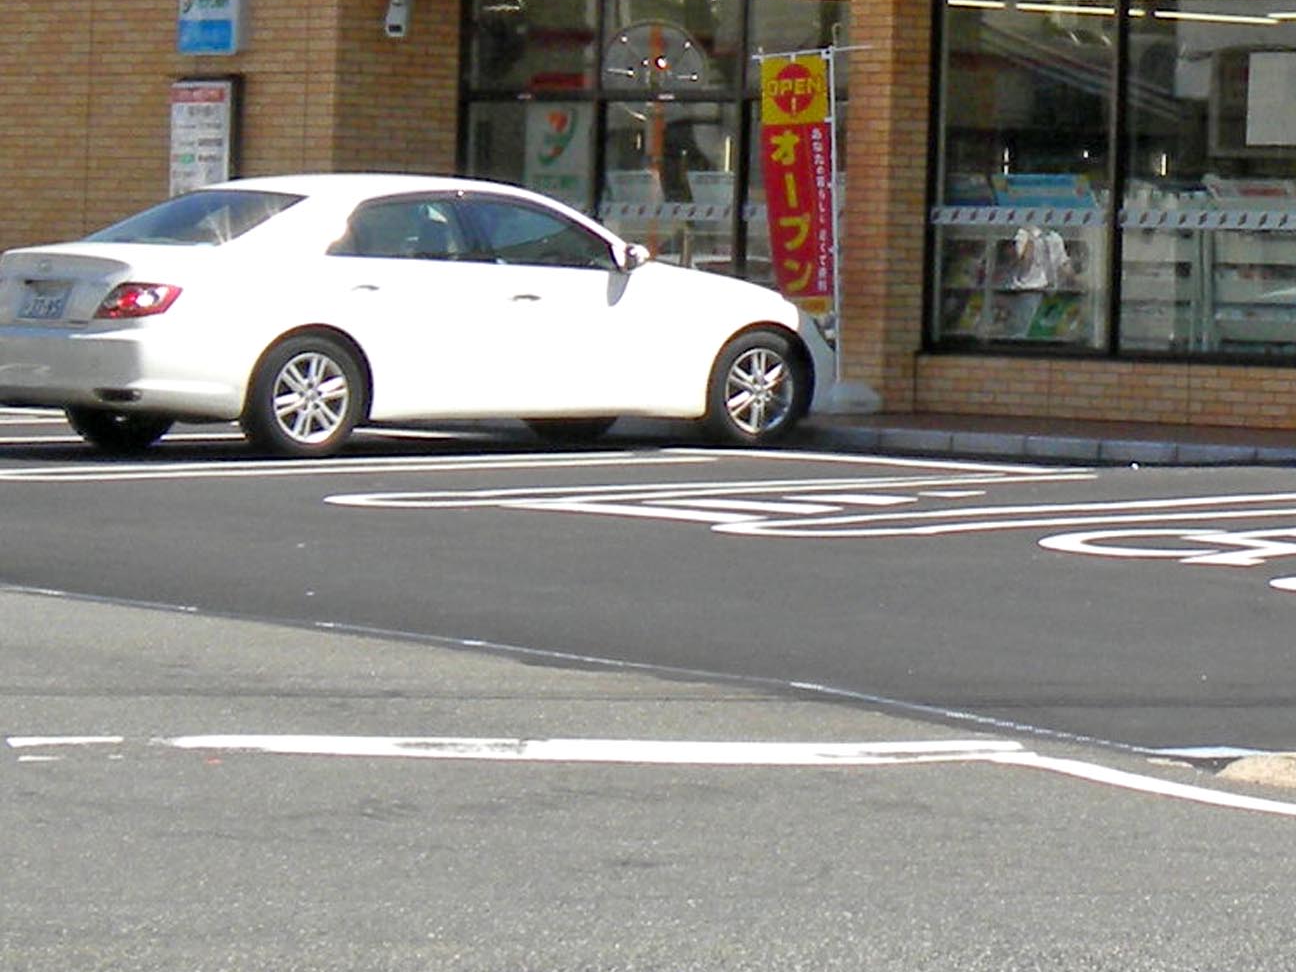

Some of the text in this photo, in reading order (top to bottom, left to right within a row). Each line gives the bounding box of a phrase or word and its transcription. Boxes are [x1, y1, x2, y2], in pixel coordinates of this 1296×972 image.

[767, 75, 824, 96] OPEN
[770, 130, 812, 292] オープン
